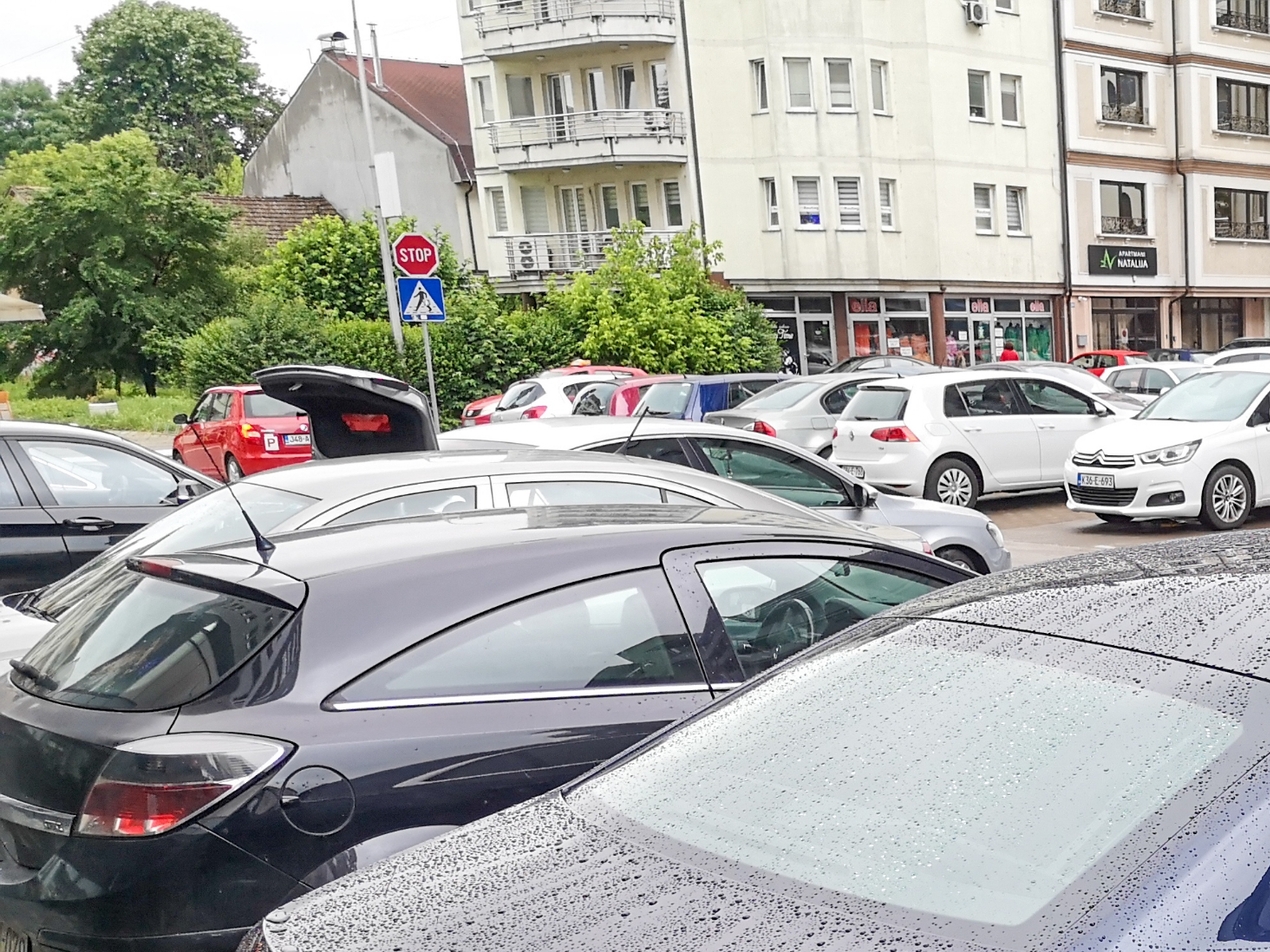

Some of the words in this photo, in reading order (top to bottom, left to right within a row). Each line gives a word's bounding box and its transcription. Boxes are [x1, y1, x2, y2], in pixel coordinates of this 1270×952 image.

[400, 248, 432, 263] STOP
[1117, 258, 1148, 269] NATALIJA
[851, 298, 878, 312] ella
[971, 299, 989, 313] ella
[267, 438, 275, 447] P
[1082, 475, 1113, 486] K36-E-693
